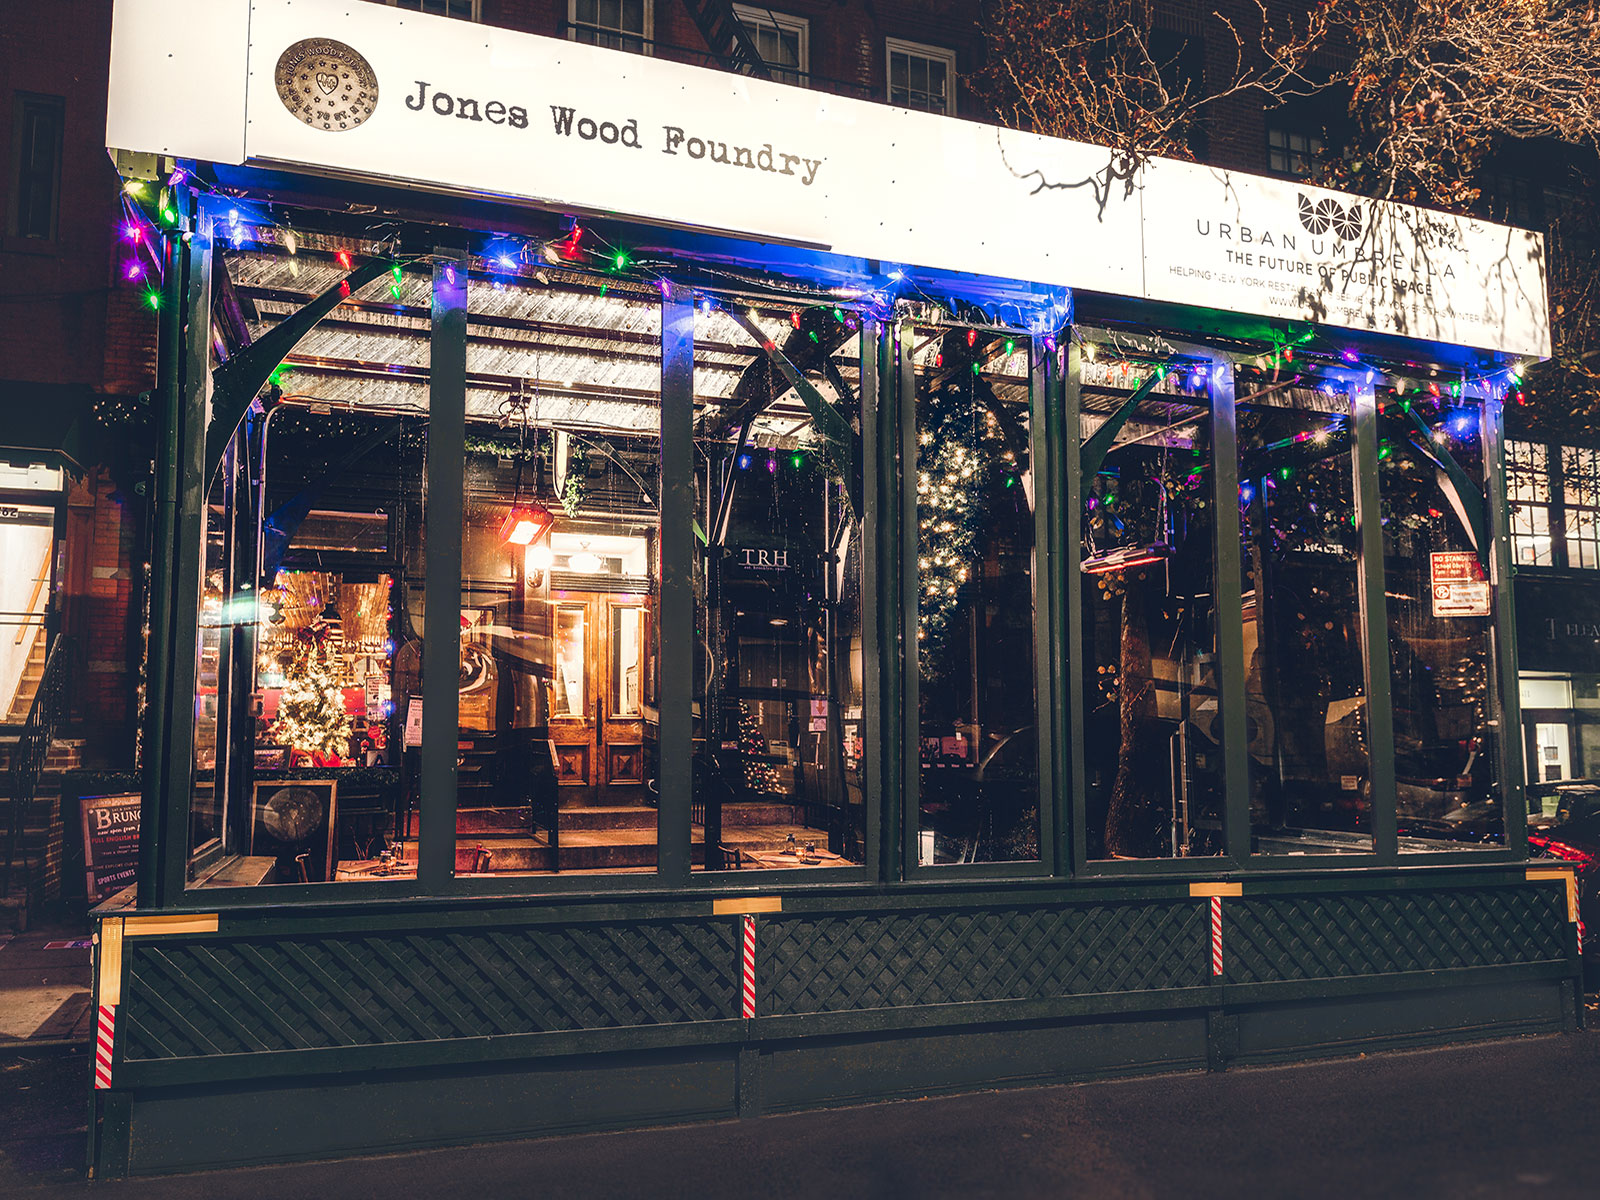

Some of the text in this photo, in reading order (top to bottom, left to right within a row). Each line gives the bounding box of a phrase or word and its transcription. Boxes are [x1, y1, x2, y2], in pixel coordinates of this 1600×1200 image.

[286, 51, 306, 76] JONES
[306, 47, 337, 57] WOOD
[404, 80, 822, 186] Jones Wood Foundry
[1197, 219, 1456, 280] URBAN UMBRELLA
[1169, 265, 1211, 281] HELPING
[1240, 276, 1265, 289] YORK
[1226, 249, 1432, 297] THE FUTURE OF PUBLIC SPACE
[742, 548, 788, 566] TRH
[97, 868, 136, 885] SPORTS EVENTS
